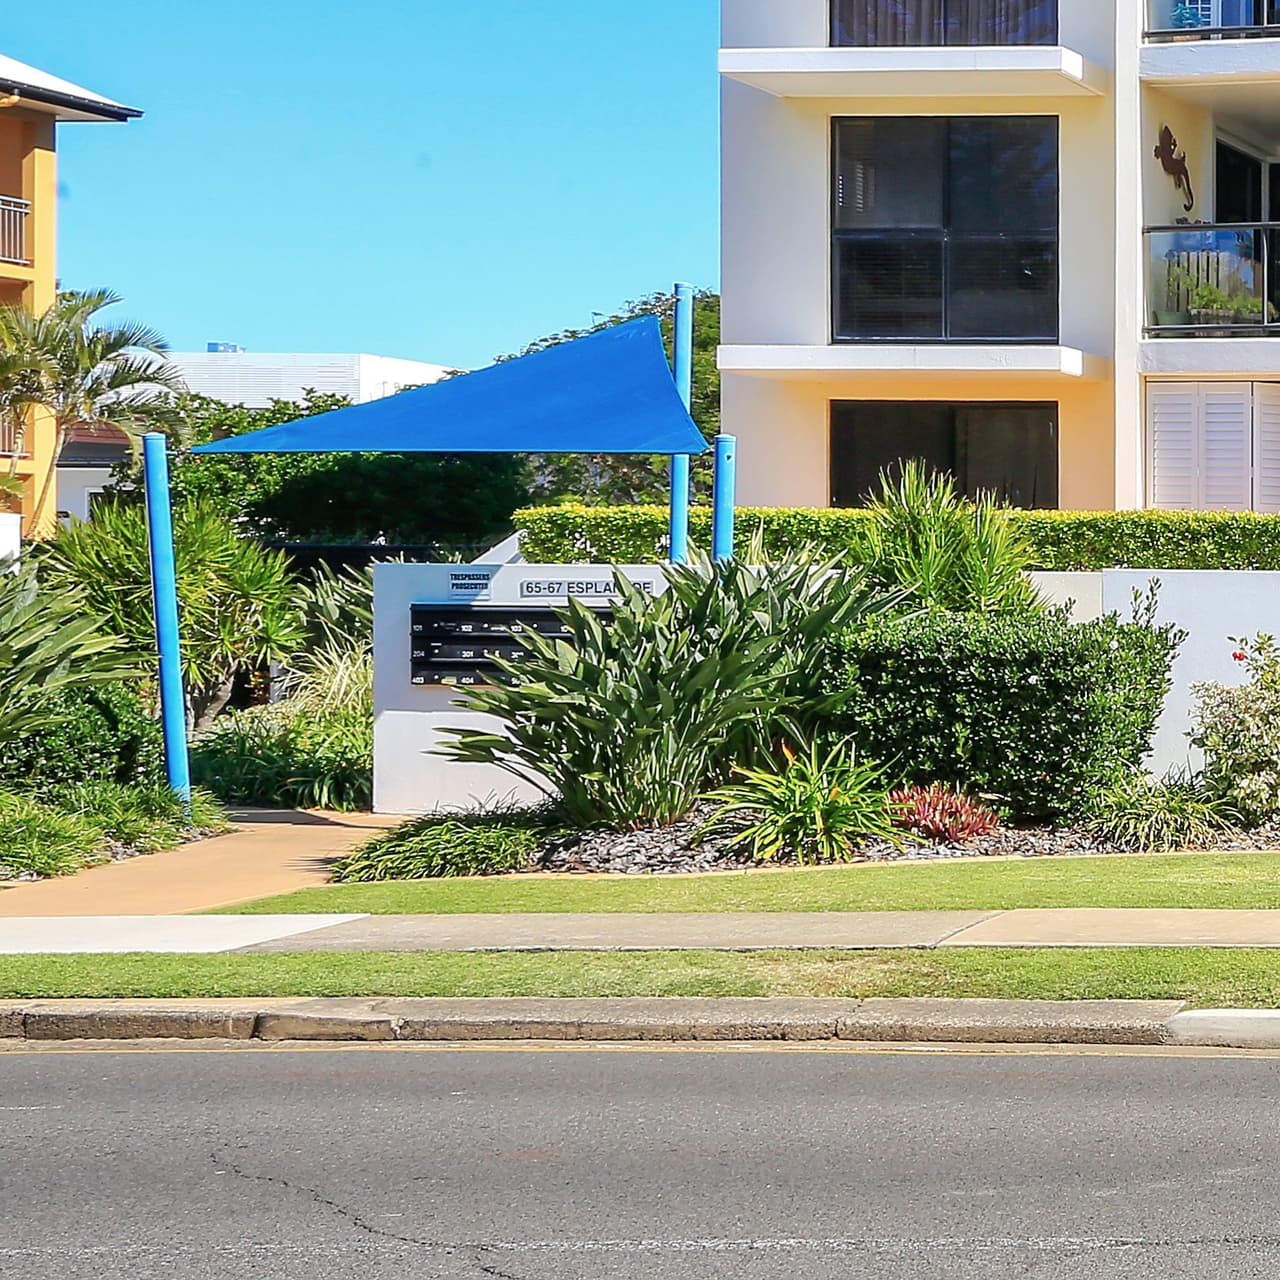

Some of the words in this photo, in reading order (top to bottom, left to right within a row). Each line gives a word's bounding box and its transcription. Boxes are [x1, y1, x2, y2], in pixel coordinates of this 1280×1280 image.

[526, 582, 562, 594] 65-67
[567, 582, 652, 594] ESPLADE
[461, 624, 473, 632] 102
